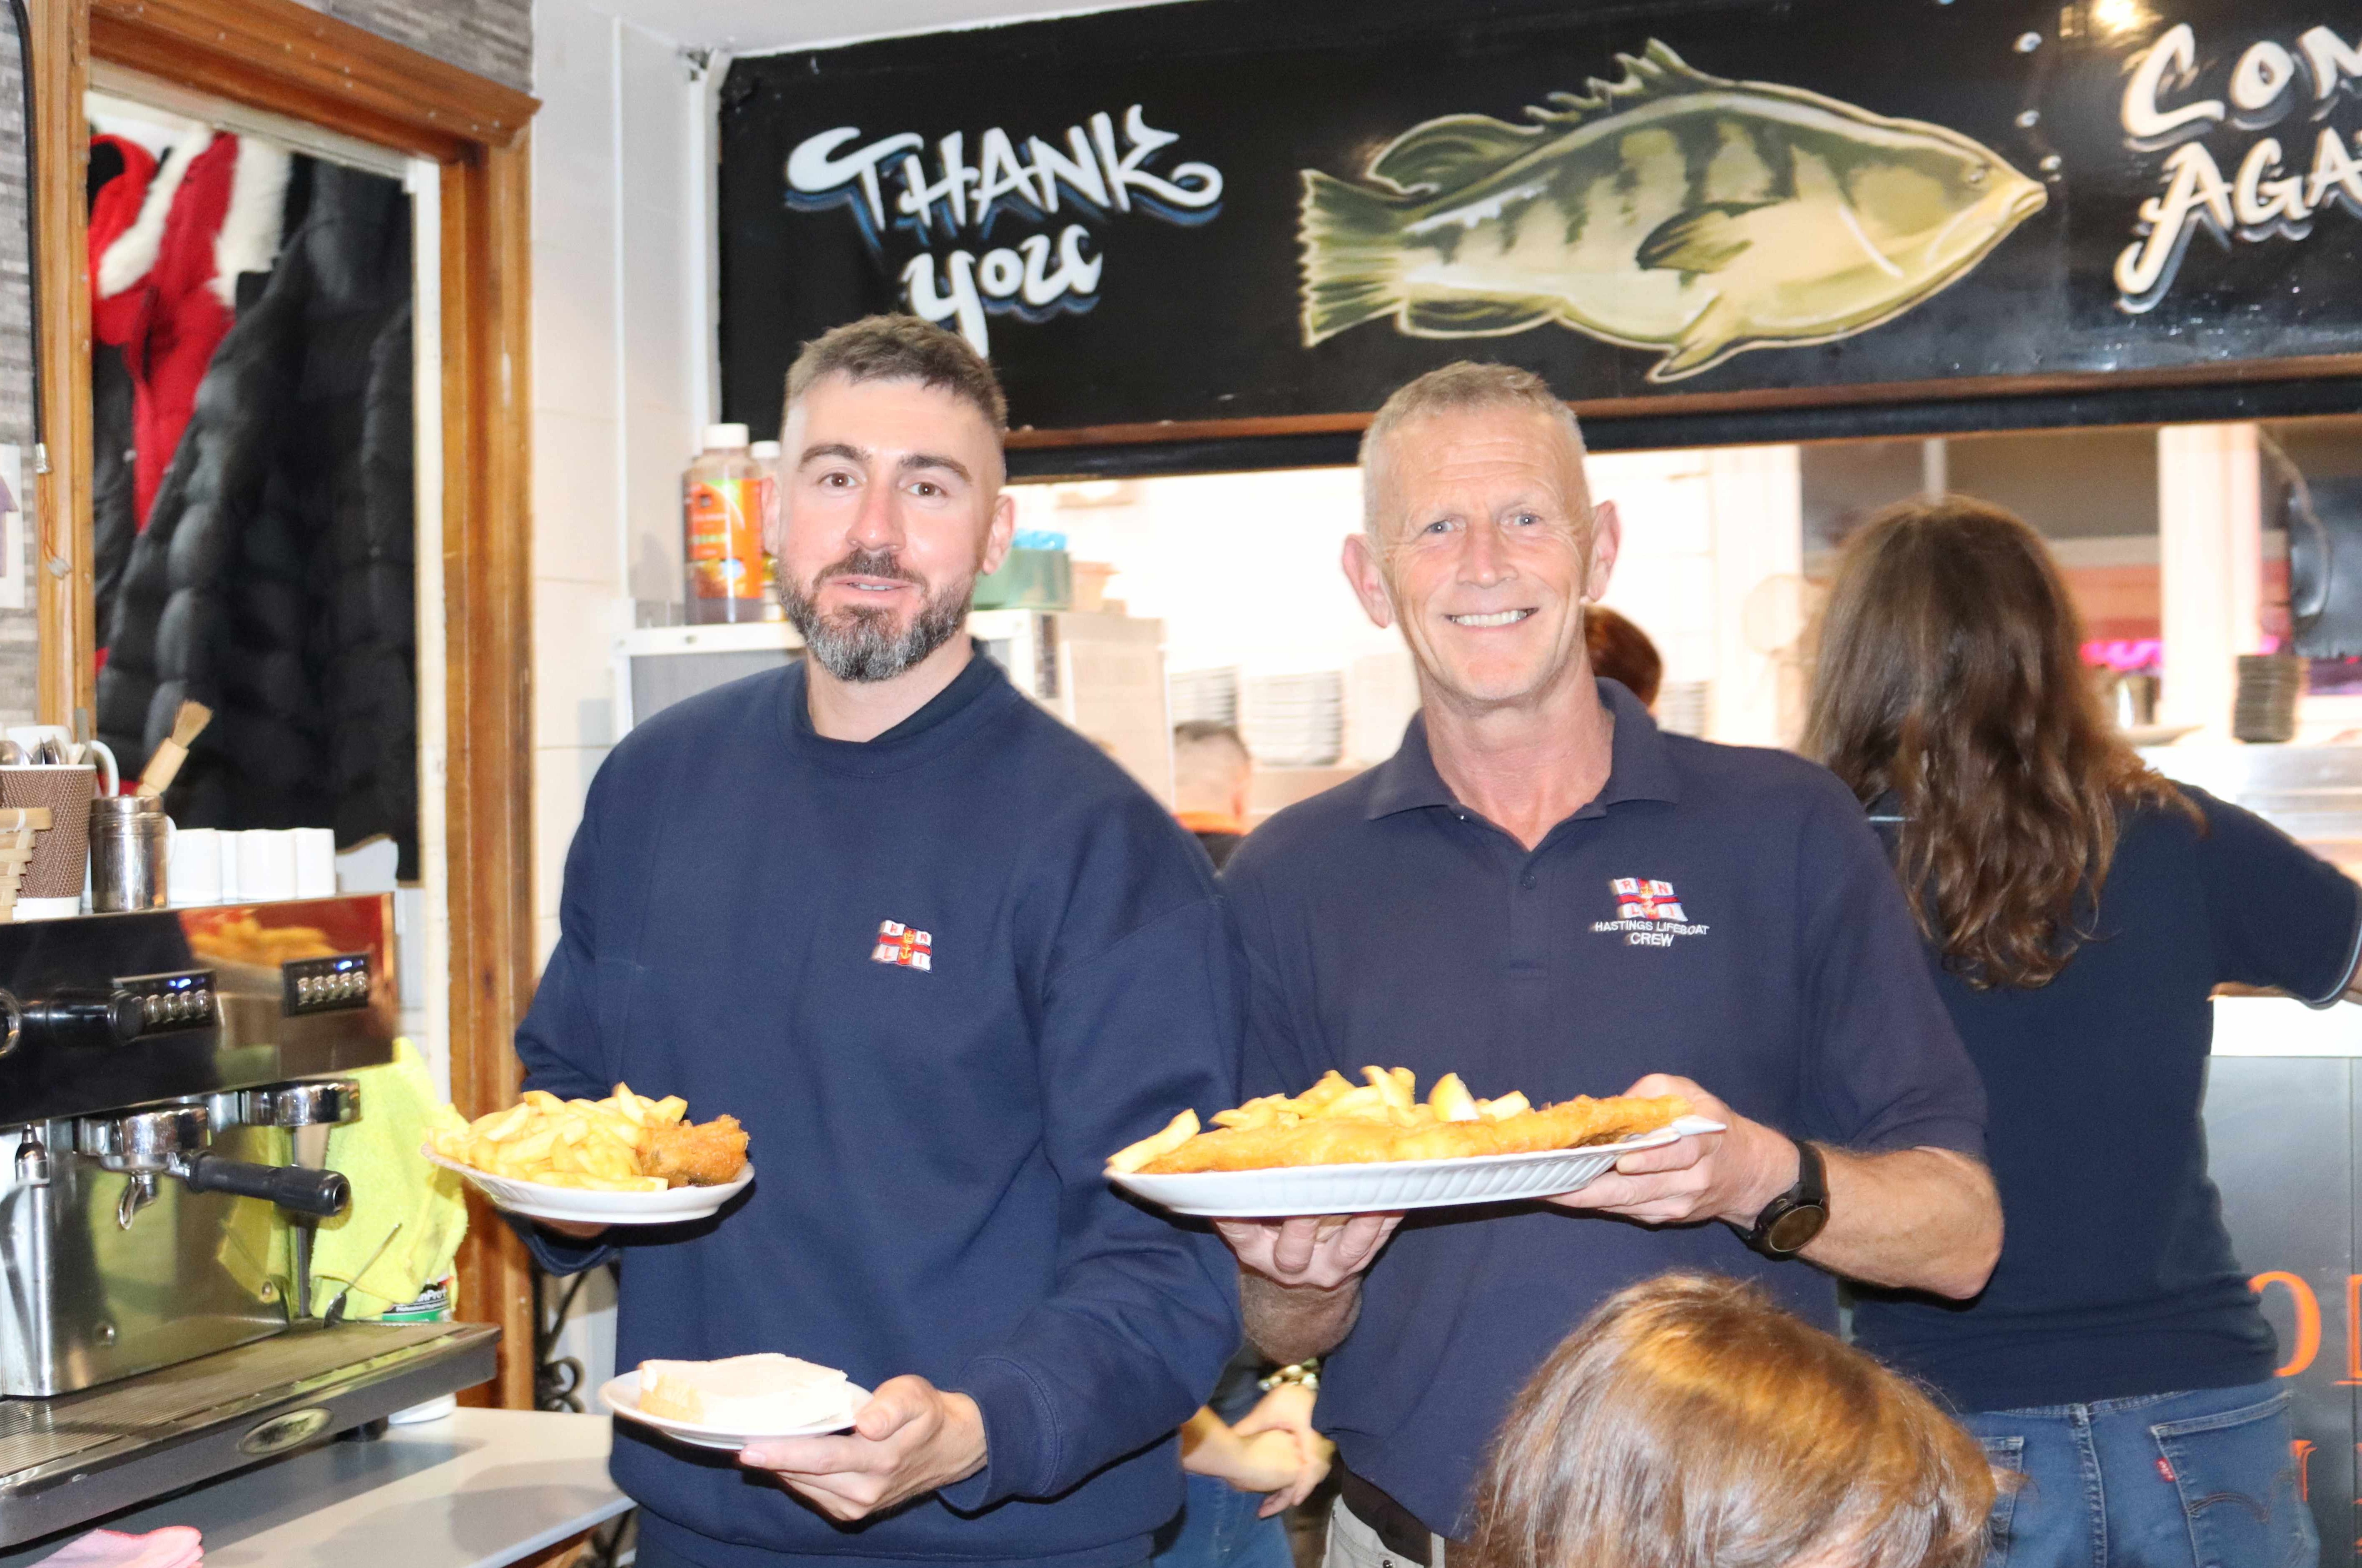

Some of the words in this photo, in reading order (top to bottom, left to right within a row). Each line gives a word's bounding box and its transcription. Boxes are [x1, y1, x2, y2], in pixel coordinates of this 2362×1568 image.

[785, 104, 1223, 232] THANK
[2114, 127, 2362, 294] AGA
[1595, 920, 1653, 932] HASTINGS
[1656, 921, 1710, 935] LIFEBOAT
[1630, 932, 1674, 947] CREW
